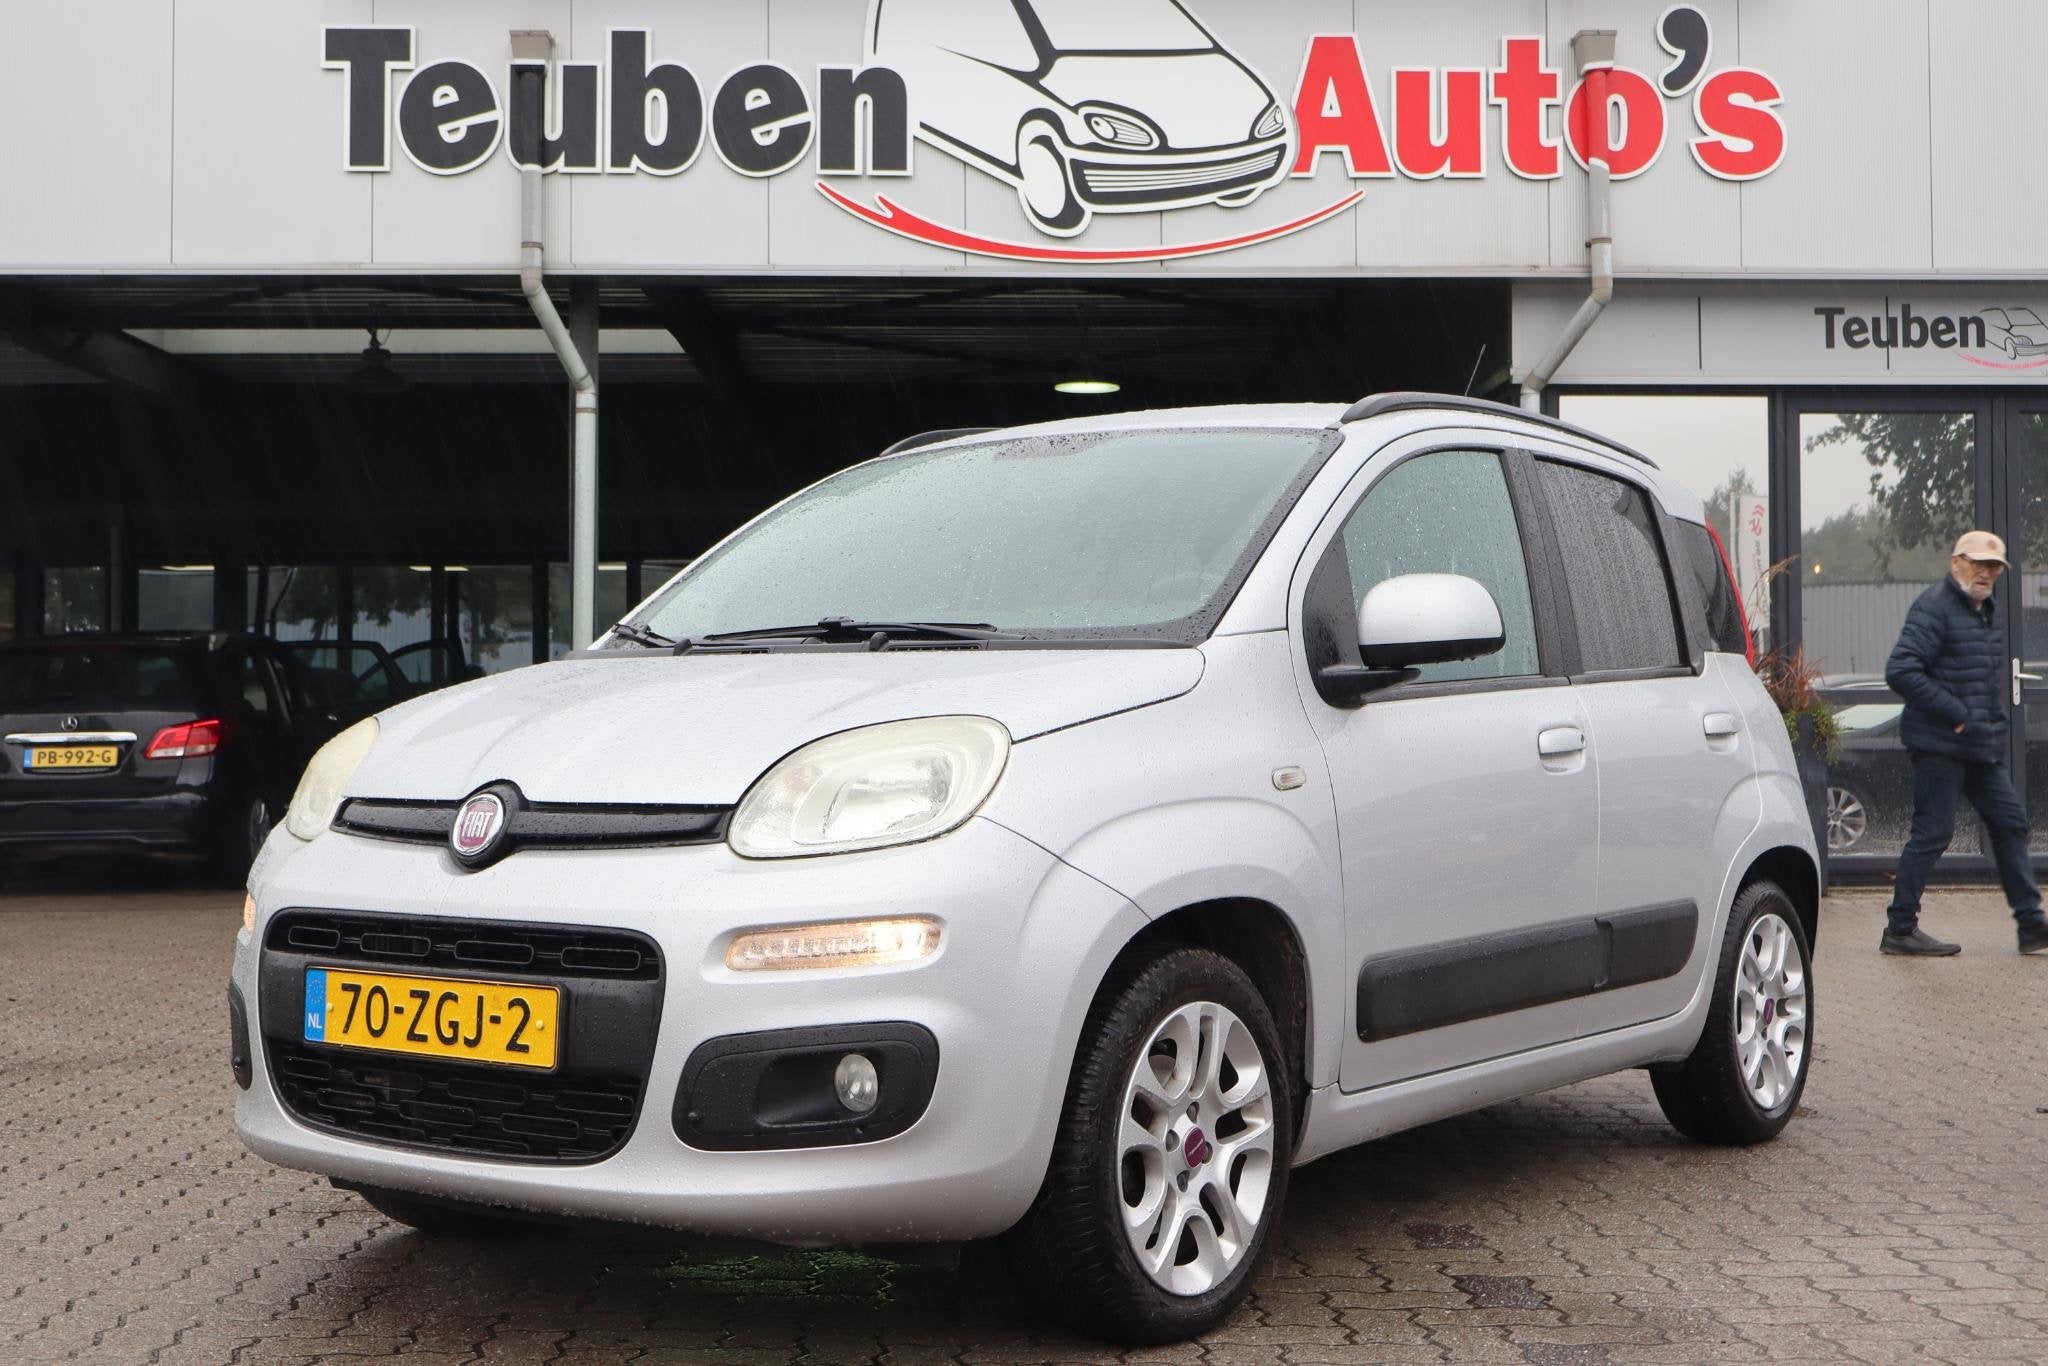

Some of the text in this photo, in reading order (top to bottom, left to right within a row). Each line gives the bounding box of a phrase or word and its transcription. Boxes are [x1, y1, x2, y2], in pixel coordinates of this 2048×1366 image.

[321, 4, 1788, 181] Teuben Auto's
[1814, 304, 1986, 349] Teuben
[37, 750, 112, 764] PB-992-G
[464, 810, 494, 838] FIAT
[308, 1012, 323, 1029] NL
[340, 983, 531, 1054] 70-ZGJ-2
